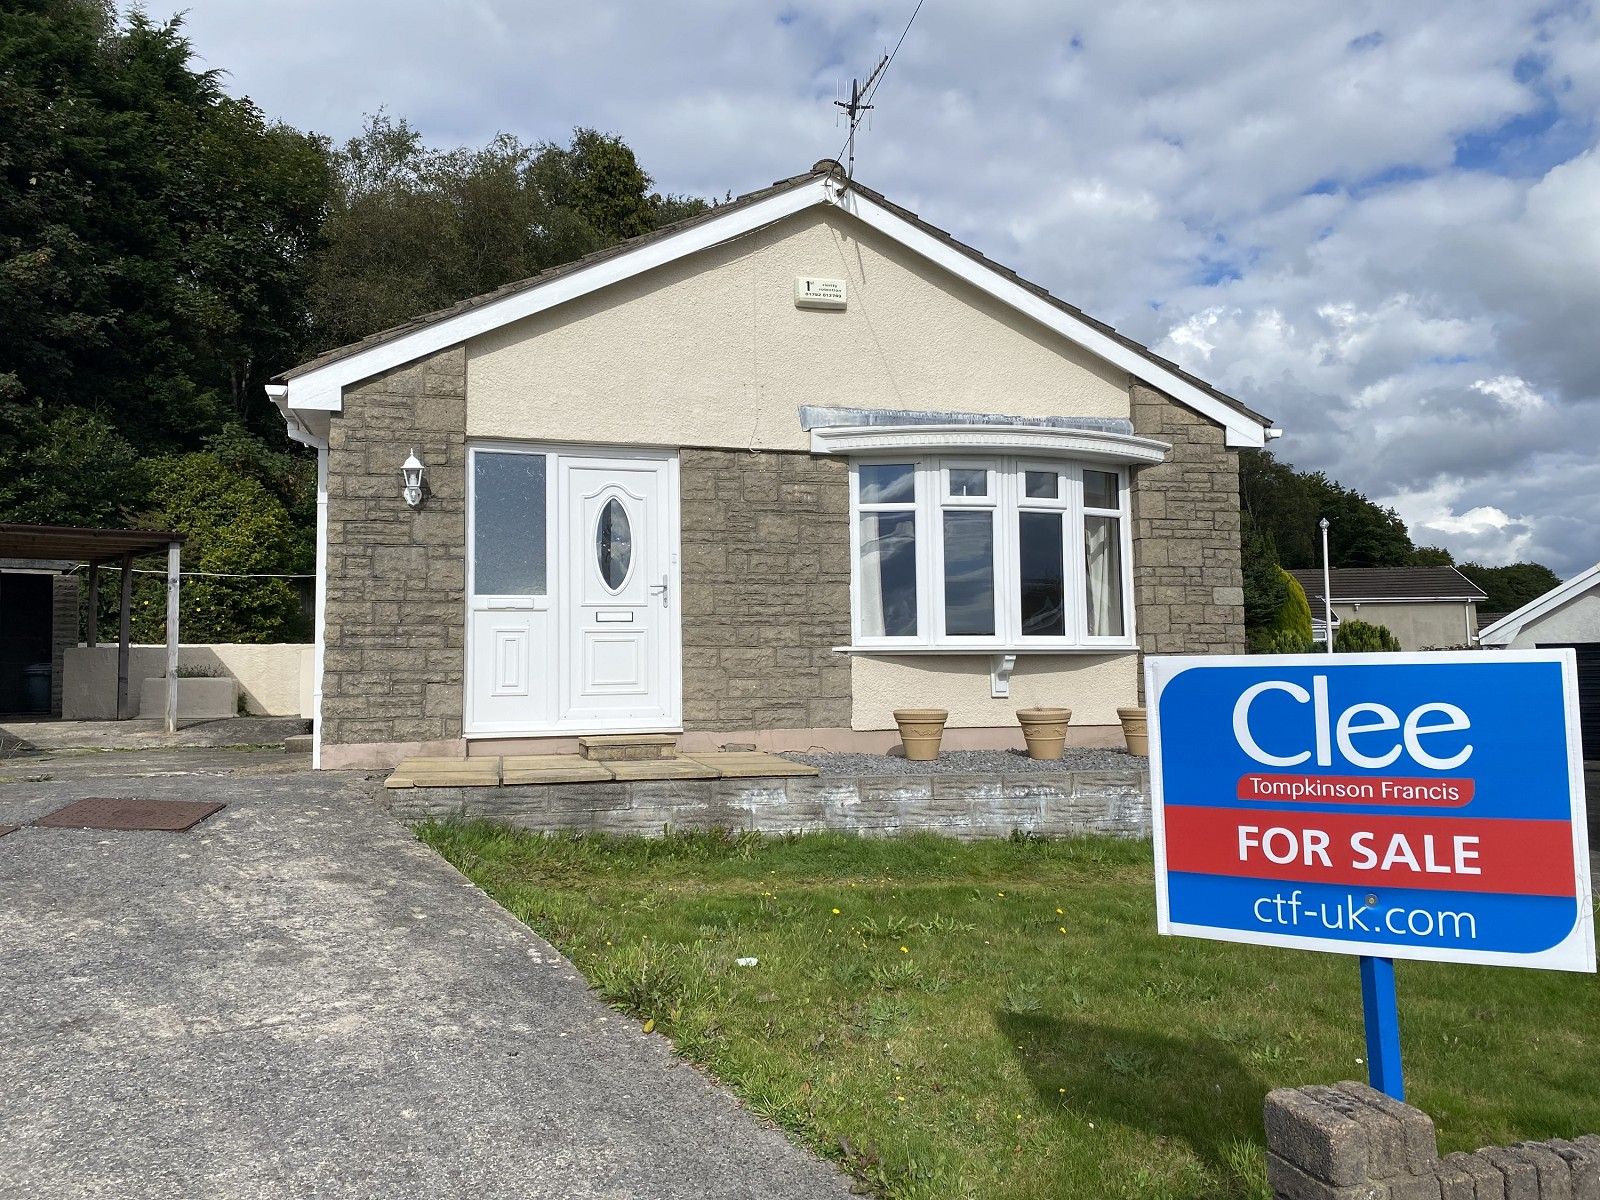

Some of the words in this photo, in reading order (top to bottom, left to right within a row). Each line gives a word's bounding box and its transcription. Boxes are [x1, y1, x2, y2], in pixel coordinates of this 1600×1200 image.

[1232, 675, 1473, 769] Clee
[1250, 778, 1374, 800] Tompkinson
[1381, 781, 1460, 801] Francis
[1238, 825, 1333, 867] FOR
[1350, 831, 1481, 875] SALE
[1254, 891, 1477, 939] ctf-uk.com
